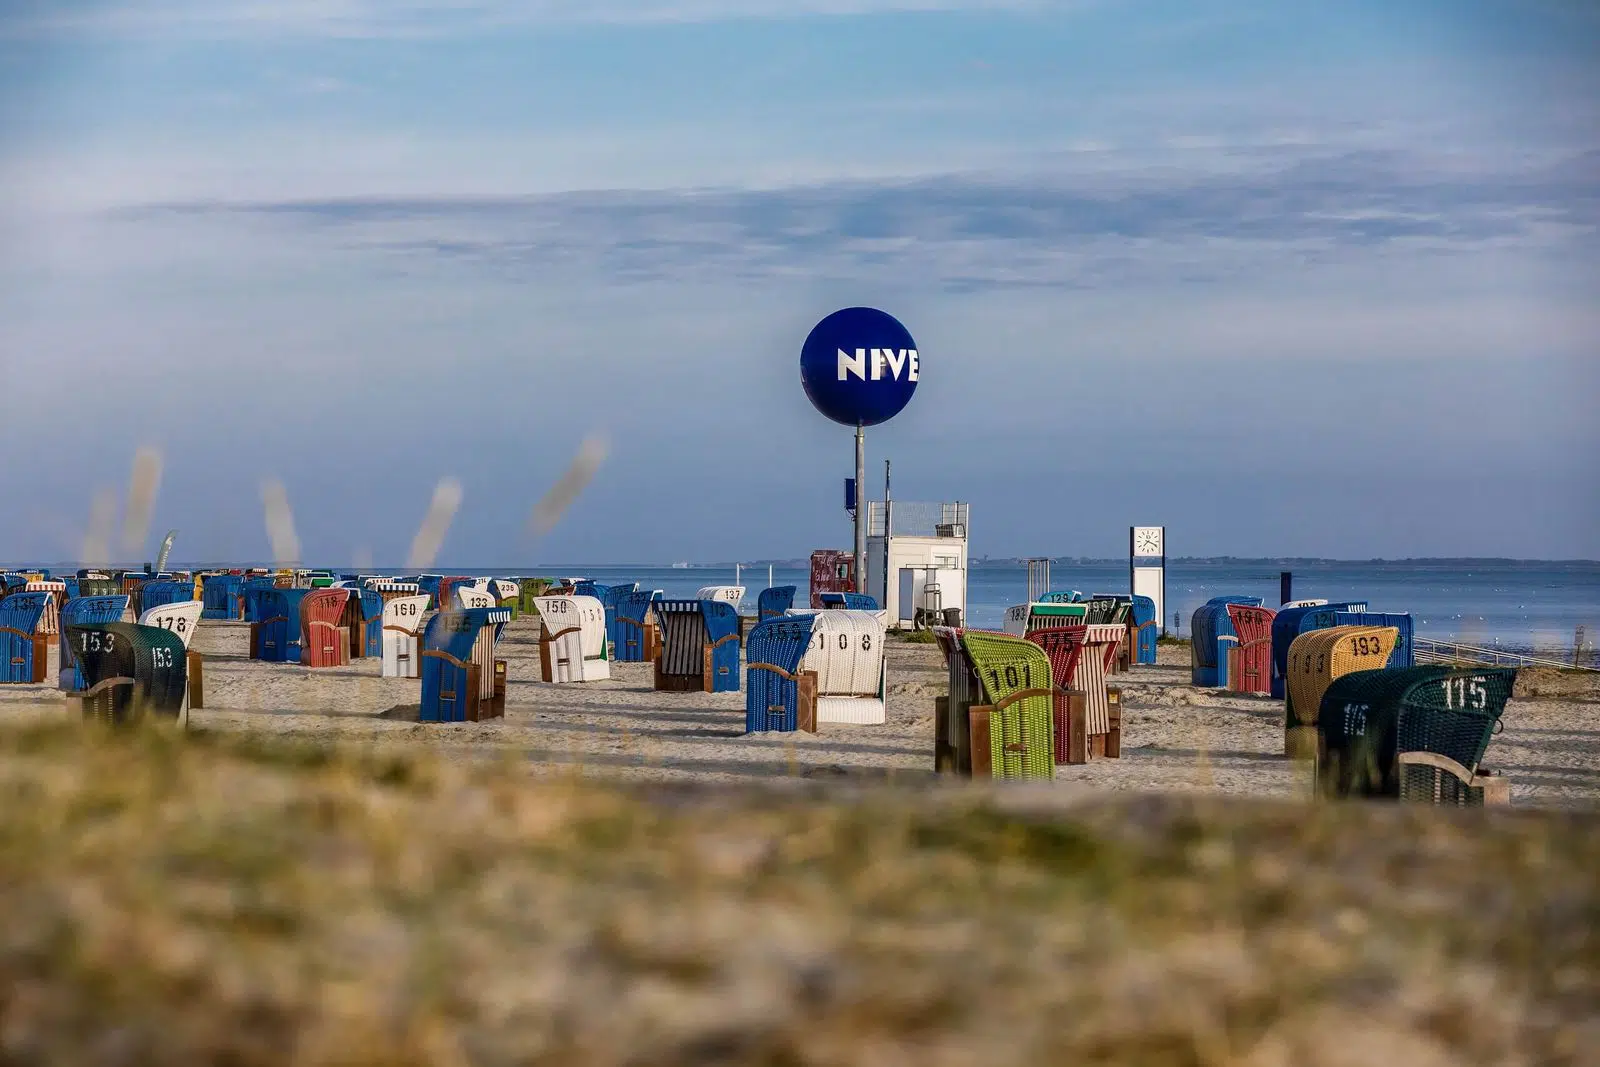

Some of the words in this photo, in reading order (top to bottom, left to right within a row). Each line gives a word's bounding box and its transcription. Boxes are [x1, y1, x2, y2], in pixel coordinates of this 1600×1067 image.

[501, 584, 515, 592] 235
[725, 590, 740, 600] 137
[470, 597, 488, 608] 133
[1051, 593, 1069, 602] 129
[394, 603, 416, 616] 160
[545, 600, 567, 613] 150
[1011, 607, 1026, 621] 183
[156, 616, 186, 633] 178
[81, 632, 115, 653] 153
[818, 633, 872, 651] 108
[1350, 636, 1380, 656] 193
[152, 647, 173, 668] 153
[1292, 653, 1324, 674] 193
[989, 664, 1031, 692] 101
[1441, 676, 1487, 709] 115
[1343, 703, 1370, 735] 115
